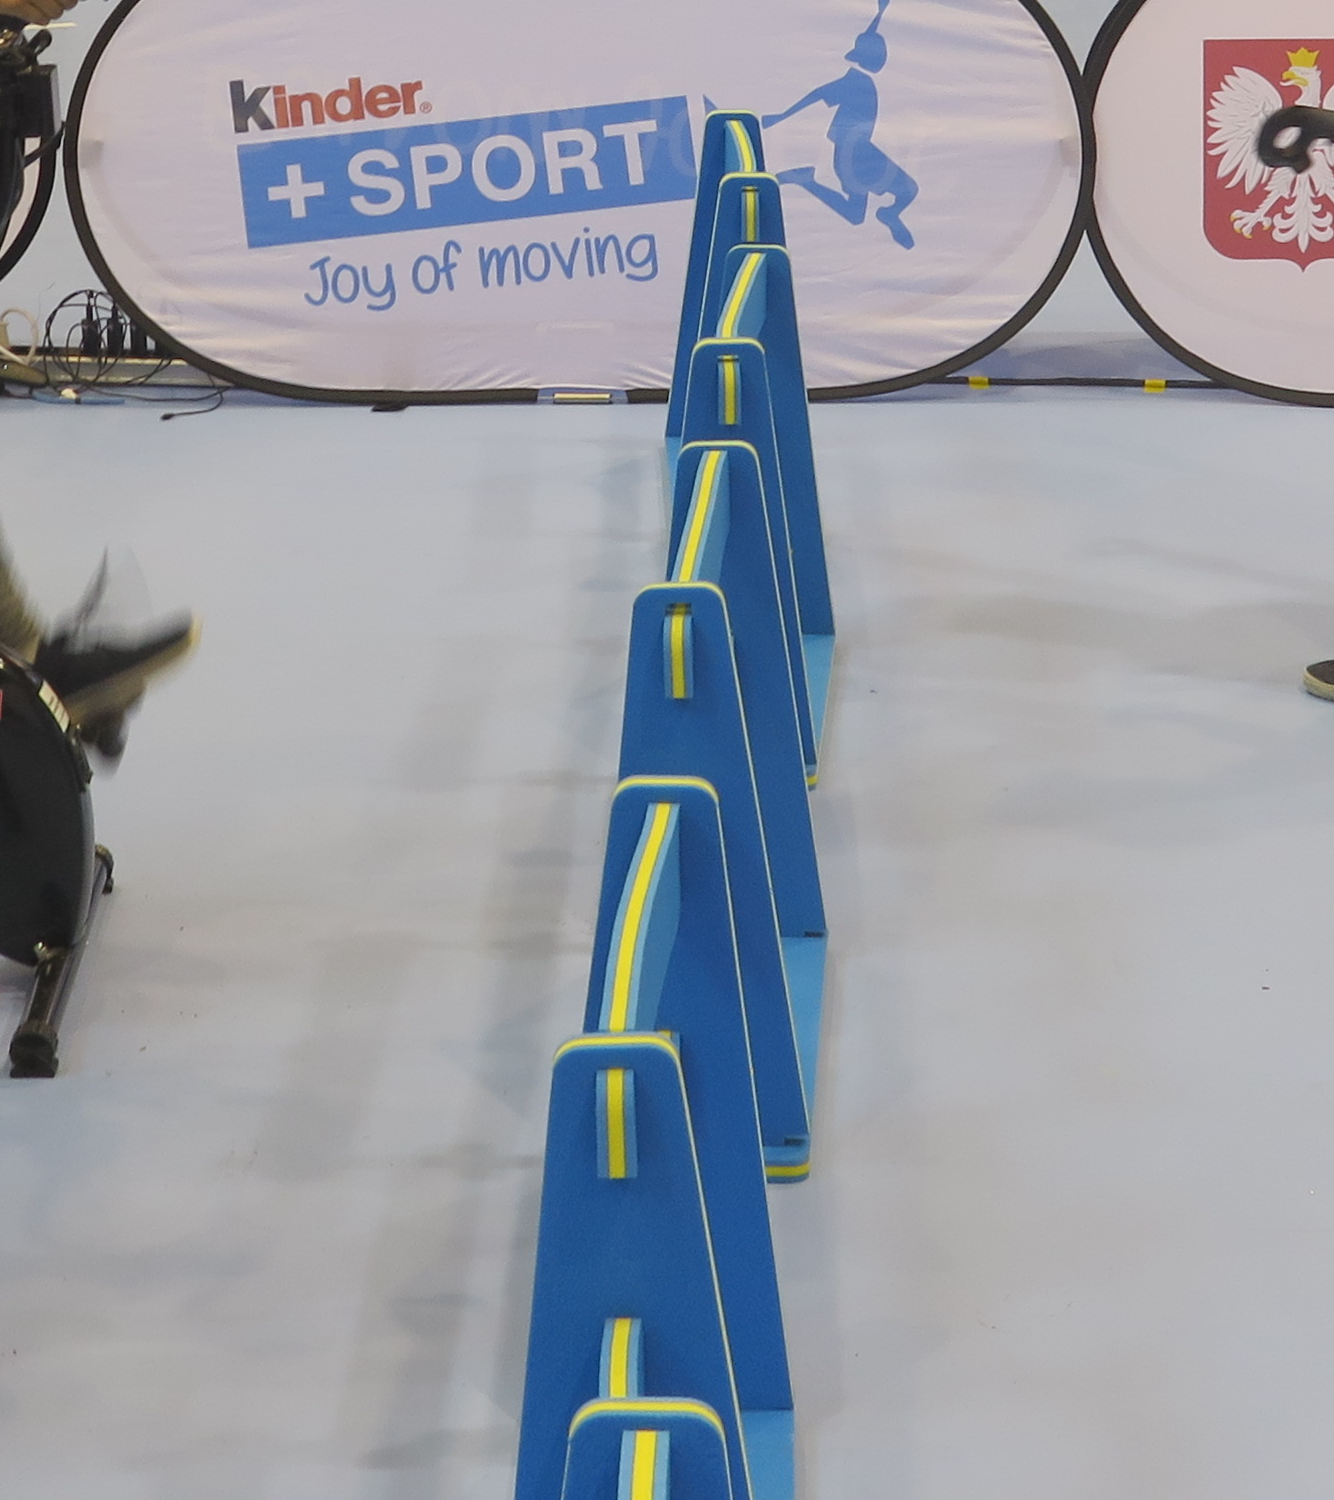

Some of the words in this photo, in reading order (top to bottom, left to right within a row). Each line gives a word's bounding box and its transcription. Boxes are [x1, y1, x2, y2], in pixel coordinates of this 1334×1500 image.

[347, 119, 658, 217] SPORT
[303, 255, 397, 312] Joy
[411, 239, 463, 295] of
[477, 226, 659, 288] moving
